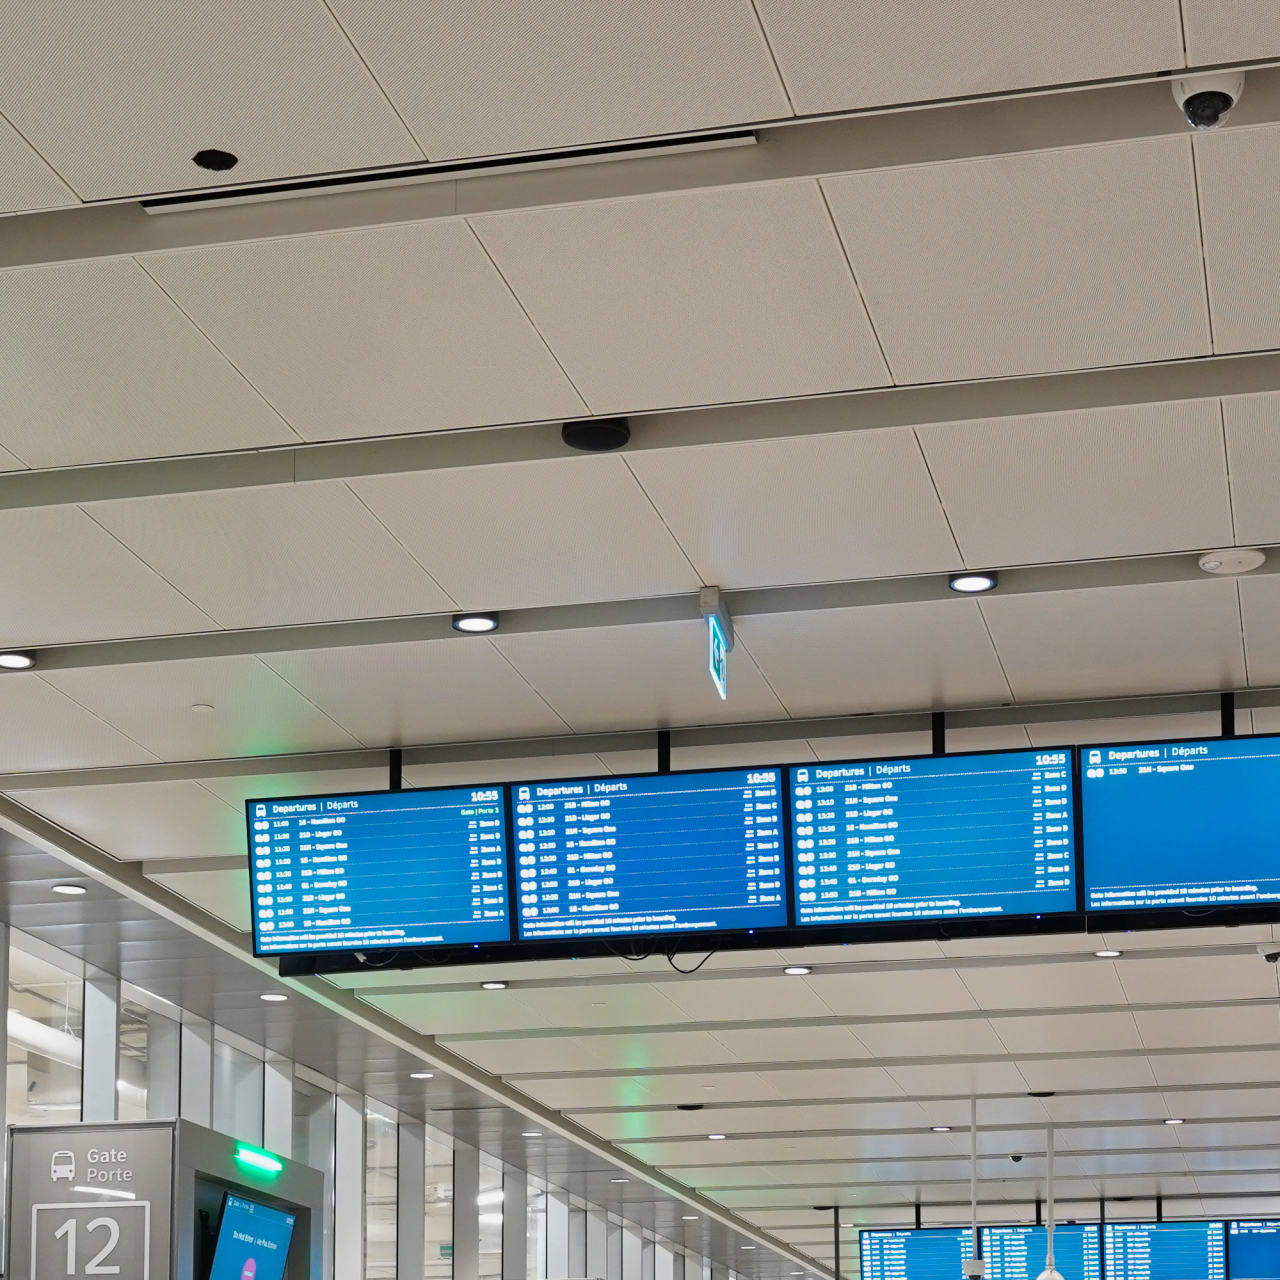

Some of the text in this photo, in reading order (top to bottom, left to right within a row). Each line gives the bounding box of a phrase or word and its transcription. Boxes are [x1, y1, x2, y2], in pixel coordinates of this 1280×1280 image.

[1036, 754, 1065, 765] 10:55
[1109, 750, 1159, 760] Departures
[1172, 747, 1207, 756] Départs
[747, 772, 775, 783] 10:55
[816, 768, 864, 778] Departures
[876, 765, 910, 774] Départs
[471, 790, 498, 801] 10:55
[537, 786, 582, 796] Departures
[594, 783, 627, 792] Départs
[273, 804, 316, 813] Departures
[327, 801, 357, 809] Départs
[87, 1148, 127, 1164] Gate
[87, 1167, 133, 1182] Porte
[53, 1216, 122, 1276] 12
